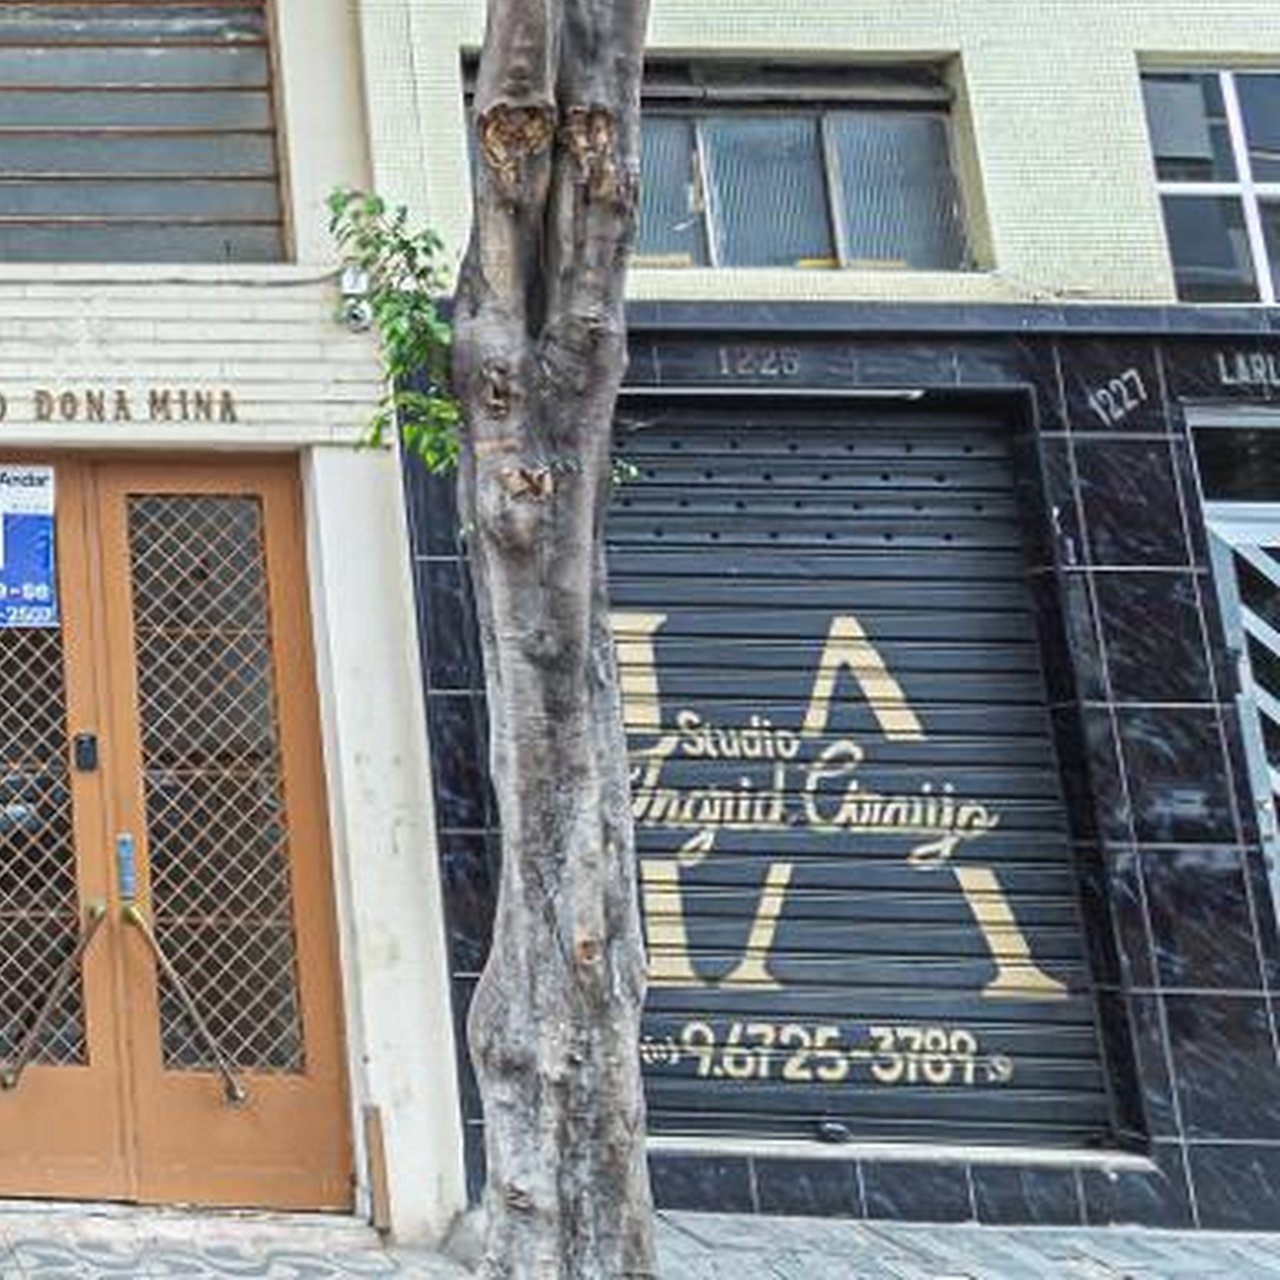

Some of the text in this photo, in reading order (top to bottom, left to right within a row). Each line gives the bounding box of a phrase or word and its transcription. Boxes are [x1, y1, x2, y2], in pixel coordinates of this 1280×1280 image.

[34, 389, 132, 422] DONA
[146, 389, 239, 423] MINA
[1089, 368, 1148, 427] 1227
[676, 710, 801, 757] Studio
